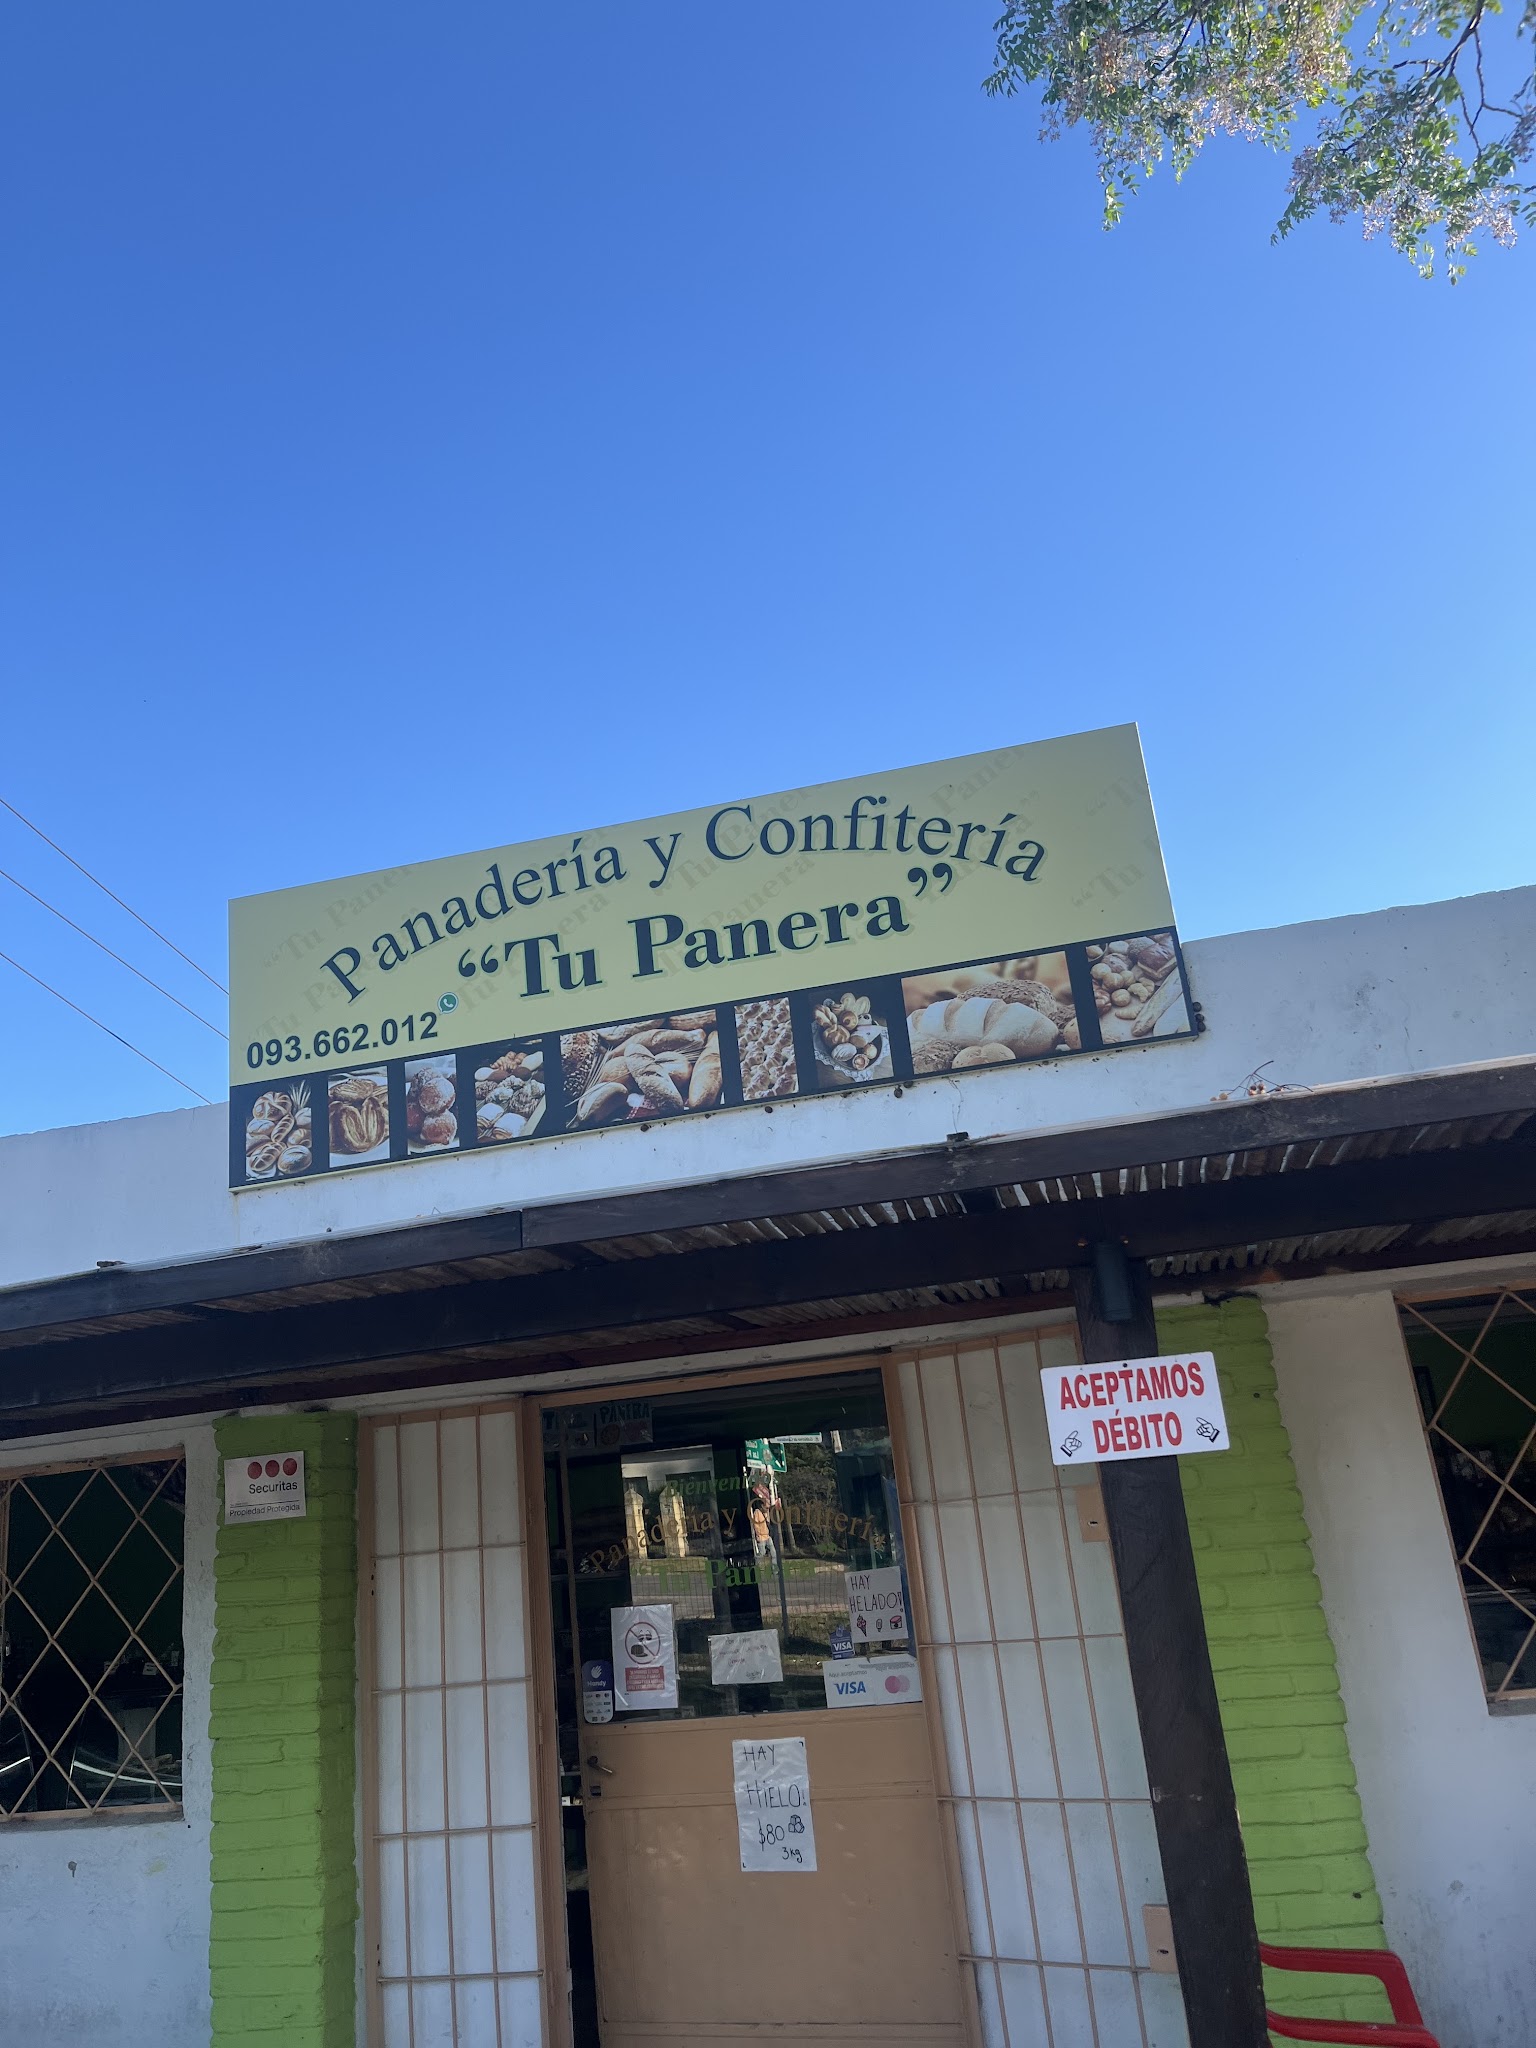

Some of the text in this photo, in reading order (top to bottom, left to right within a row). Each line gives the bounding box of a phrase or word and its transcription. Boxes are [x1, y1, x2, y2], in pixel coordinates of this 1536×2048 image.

[320, 838, 627, 1004] Panadería
[643, 832, 682, 889] y
[705, 795, 1048, 882] Confitería
[457, 934, 603, 998] “Tu
[627, 862, 953, 979] Panera”
[246, 1011, 438, 1070] 093.662.012
[1060, 1362, 1205, 1410] ACEPTAMOS
[1092, 1409, 1183, 1454] DÉBITO
[248, 1480, 298, 1494] Securitas
[229, 1503, 301, 1517] Propiedad Protegida
[720, 1506, 738, 1536] y
[850, 1575, 870, 1591] HAY
[832, 1641, 853, 1652] VISA
[833, 1681, 867, 1695] VISA
[743, 1745, 775, 1771] HAY
[758, 1818, 785, 1852] $80
